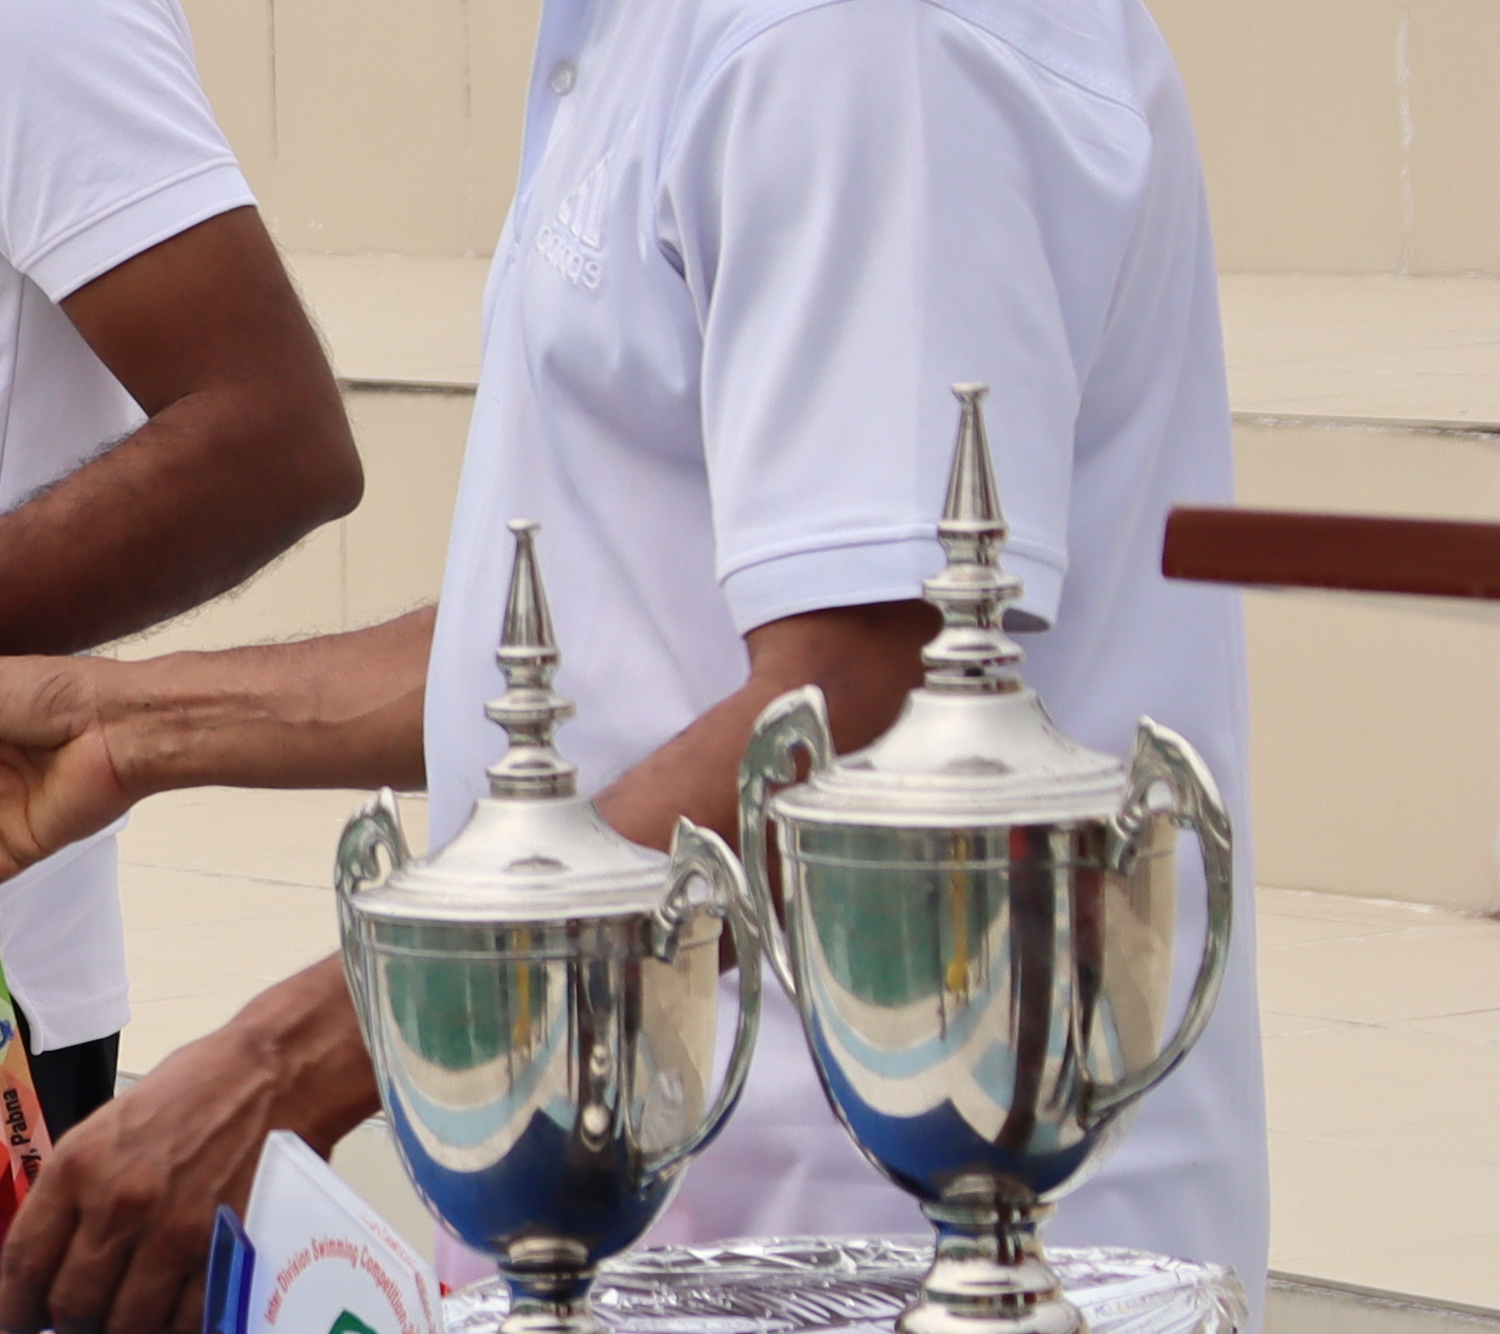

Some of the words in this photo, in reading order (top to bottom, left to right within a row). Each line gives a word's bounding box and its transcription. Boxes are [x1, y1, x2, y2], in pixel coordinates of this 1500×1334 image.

[3, 1088, 31, 1147] Pabna
[276, 1248, 312, 1294] Division
[311, 1234, 359, 1270] Swimming
